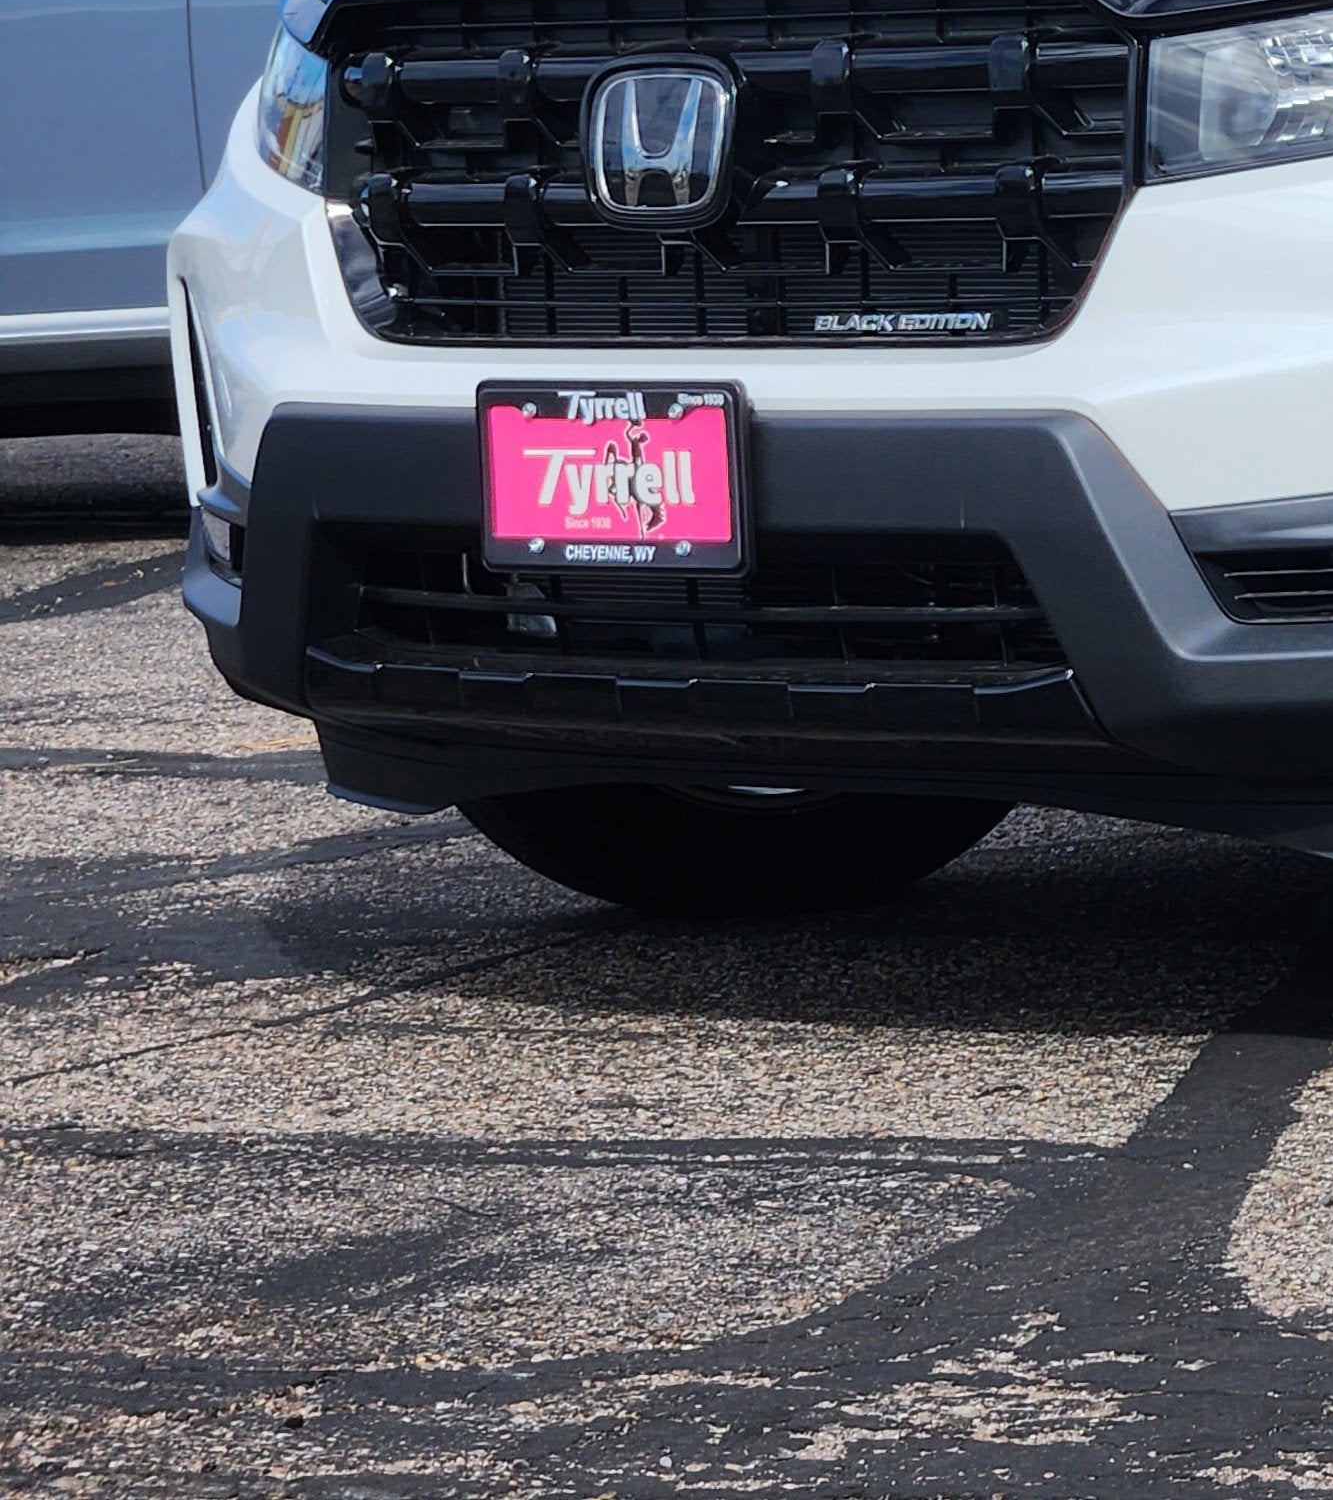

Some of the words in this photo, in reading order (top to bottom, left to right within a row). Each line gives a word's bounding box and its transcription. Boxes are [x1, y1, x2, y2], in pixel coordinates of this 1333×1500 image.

[814, 314, 896, 332] BLACK
[897, 311, 991, 331] EDITION
[556, 390, 646, 426] Tyrrell
[522, 448, 695, 516] Tyrrell
[565, 516, 590, 530] Since
